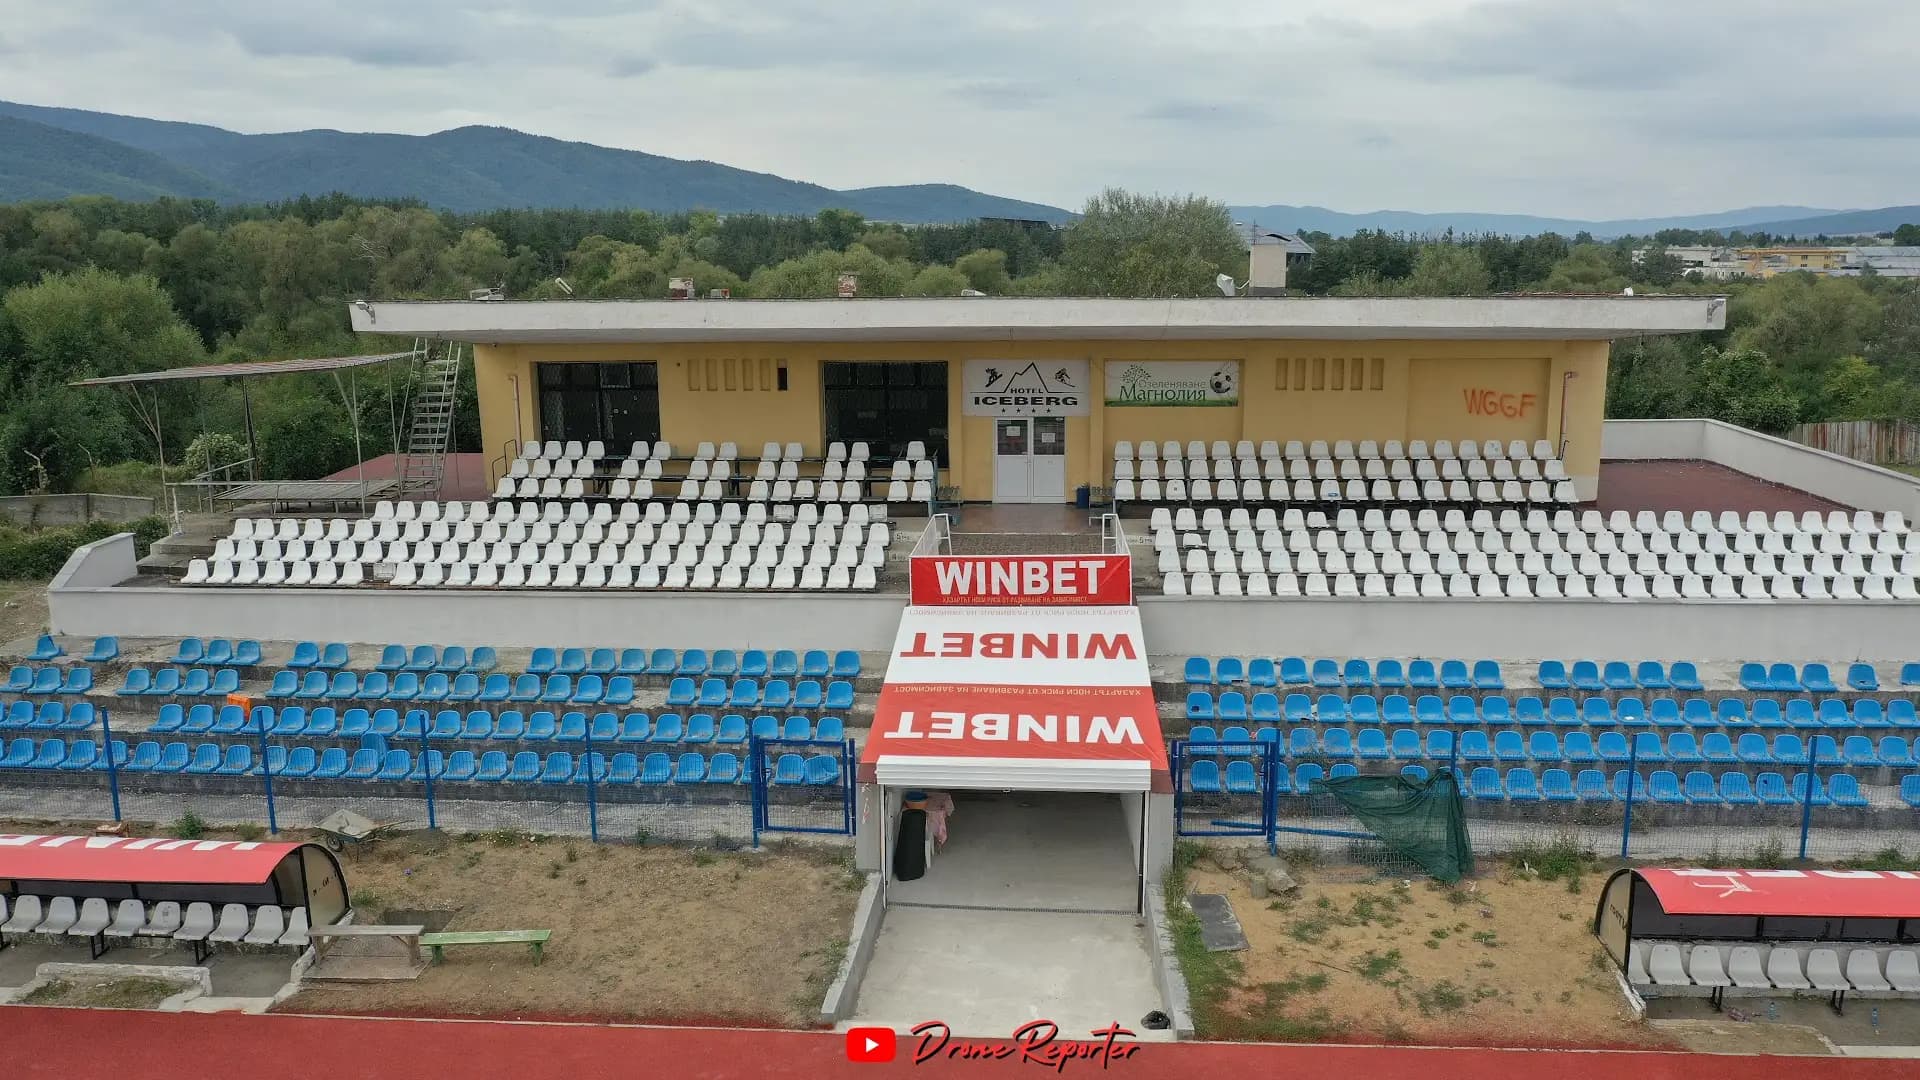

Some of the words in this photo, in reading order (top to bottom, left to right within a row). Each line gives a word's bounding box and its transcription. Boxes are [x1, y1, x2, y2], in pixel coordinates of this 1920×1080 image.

[974, 396, 1078, 406] ICEBERG
[1119, 385, 1206, 401] Магнолия
[1463, 388, 1537, 418] WGGF
[934, 560, 1106, 595] WINBET
[900, 632, 1137, 660] WINBET
[1027, 687, 1038, 695] ОТ
[883, 711, 1145, 744] WINBET
